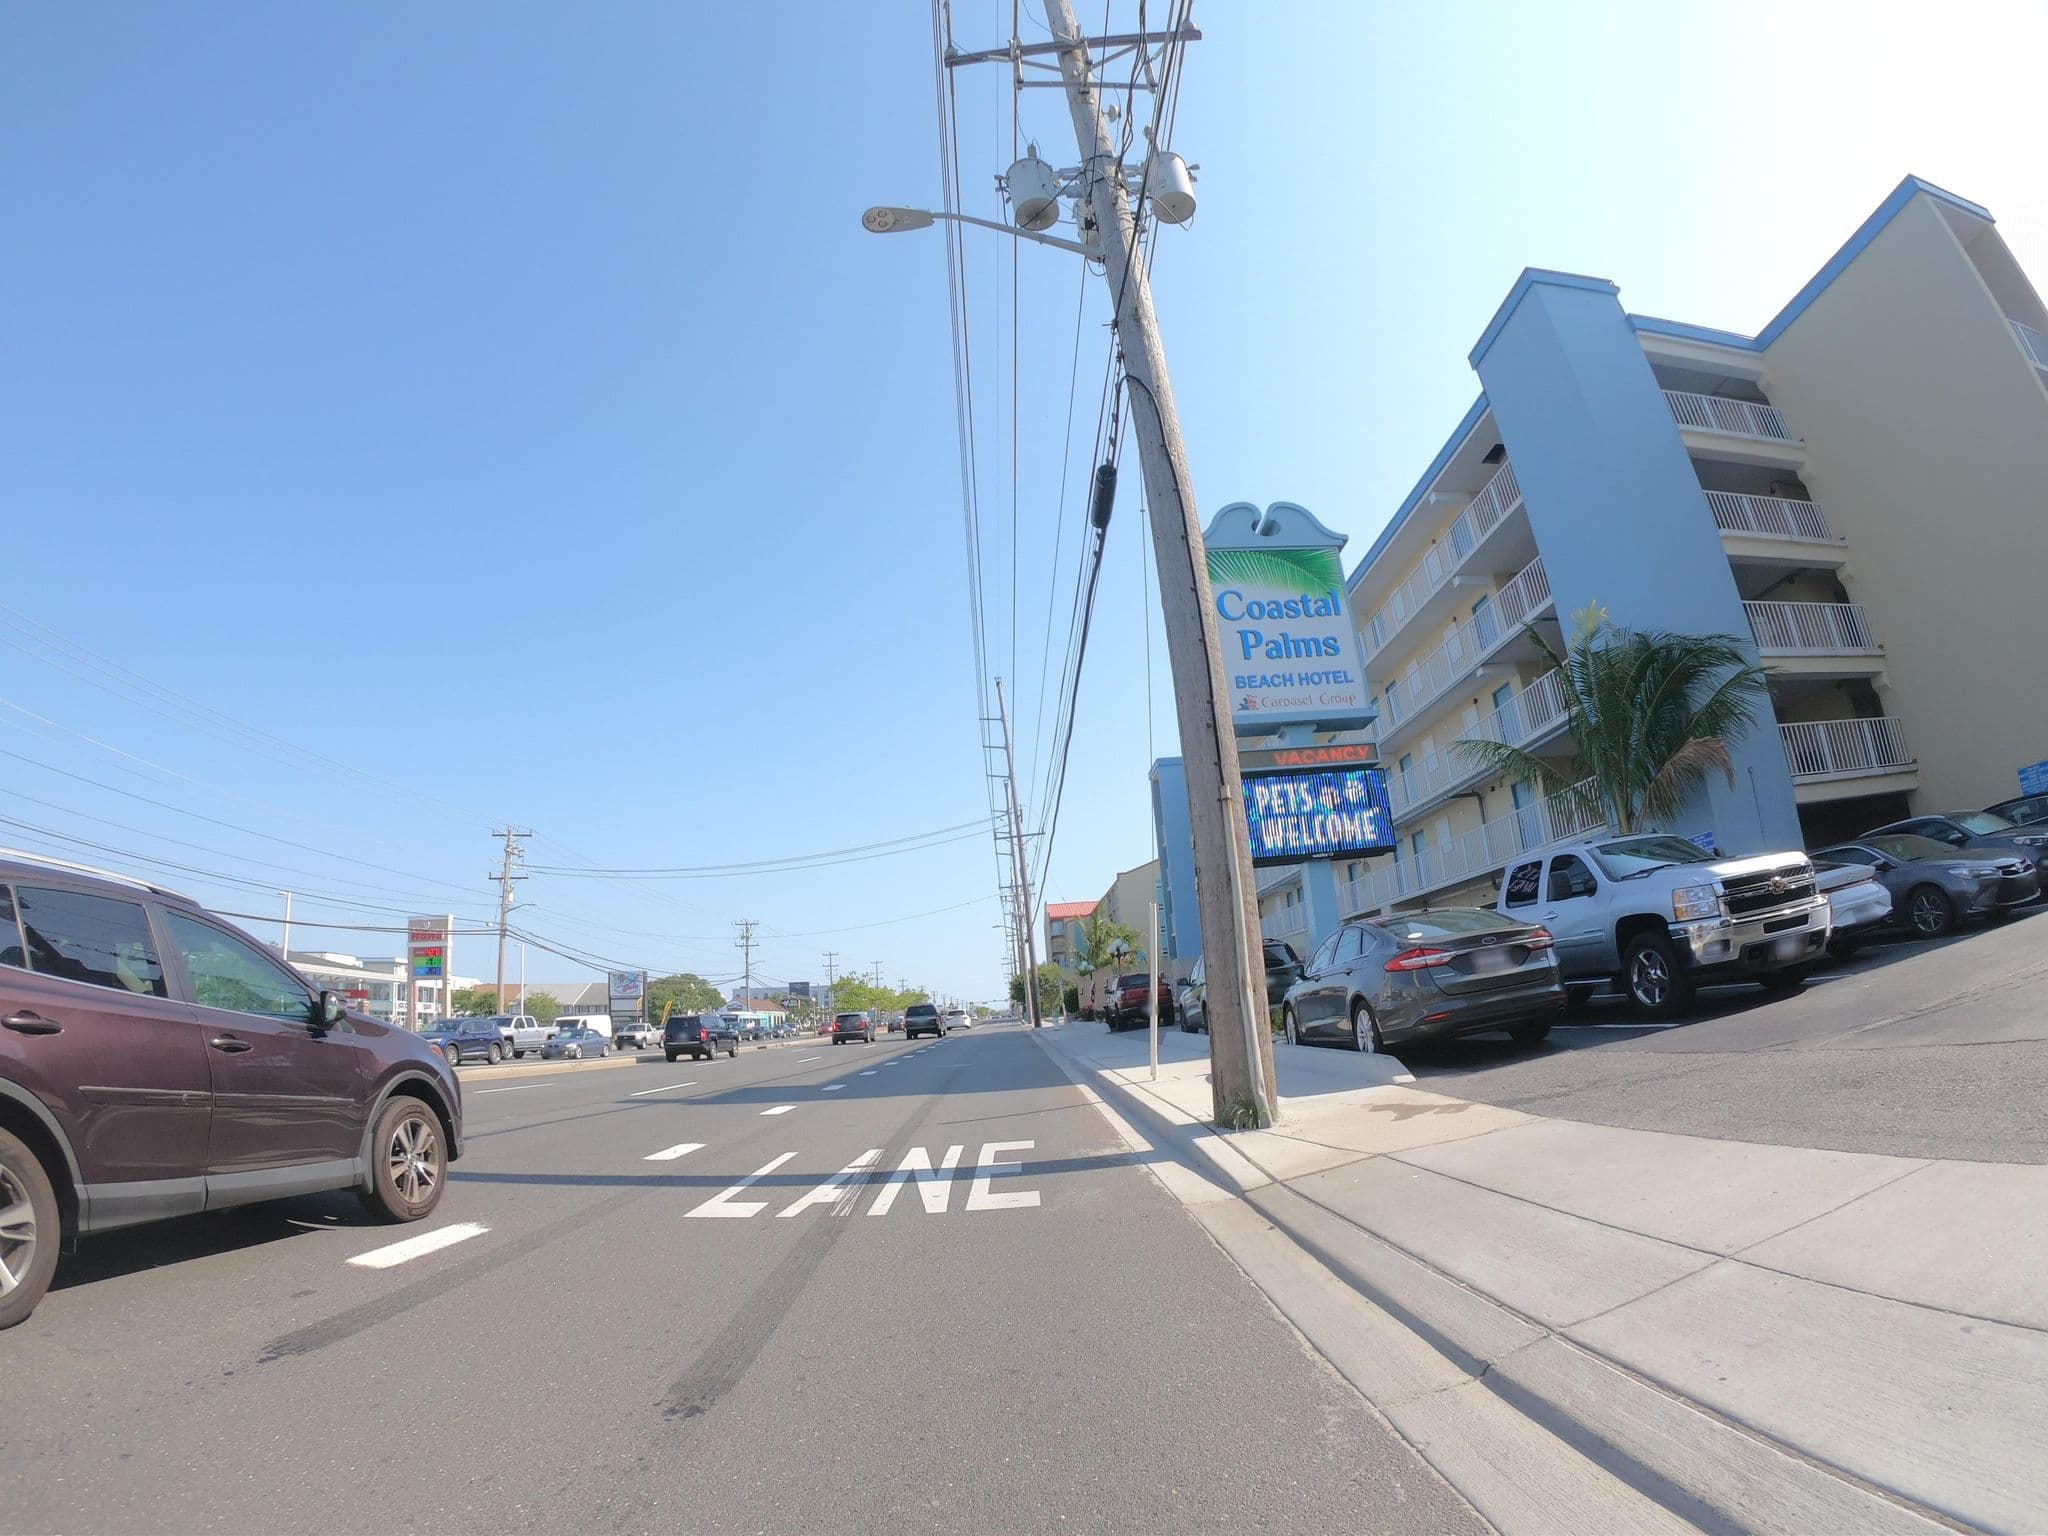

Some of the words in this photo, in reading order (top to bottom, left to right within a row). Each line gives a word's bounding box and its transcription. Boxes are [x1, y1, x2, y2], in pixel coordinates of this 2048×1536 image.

[1216, 588, 1342, 622] Coastal
[1236, 629, 1342, 661] Palms
[1234, 672, 1295, 689] BEACH
[1297, 670, 1354, 687] HOTEL
[1261, 693, 1313, 709] Carousel
[1319, 692, 1357, 706] Group
[1273, 745, 1370, 766] VACANCY
[1255, 782, 1314, 815] PETS
[1261, 806, 1382, 849] WELCOME
[683, 1140, 1041, 1218] LANE
